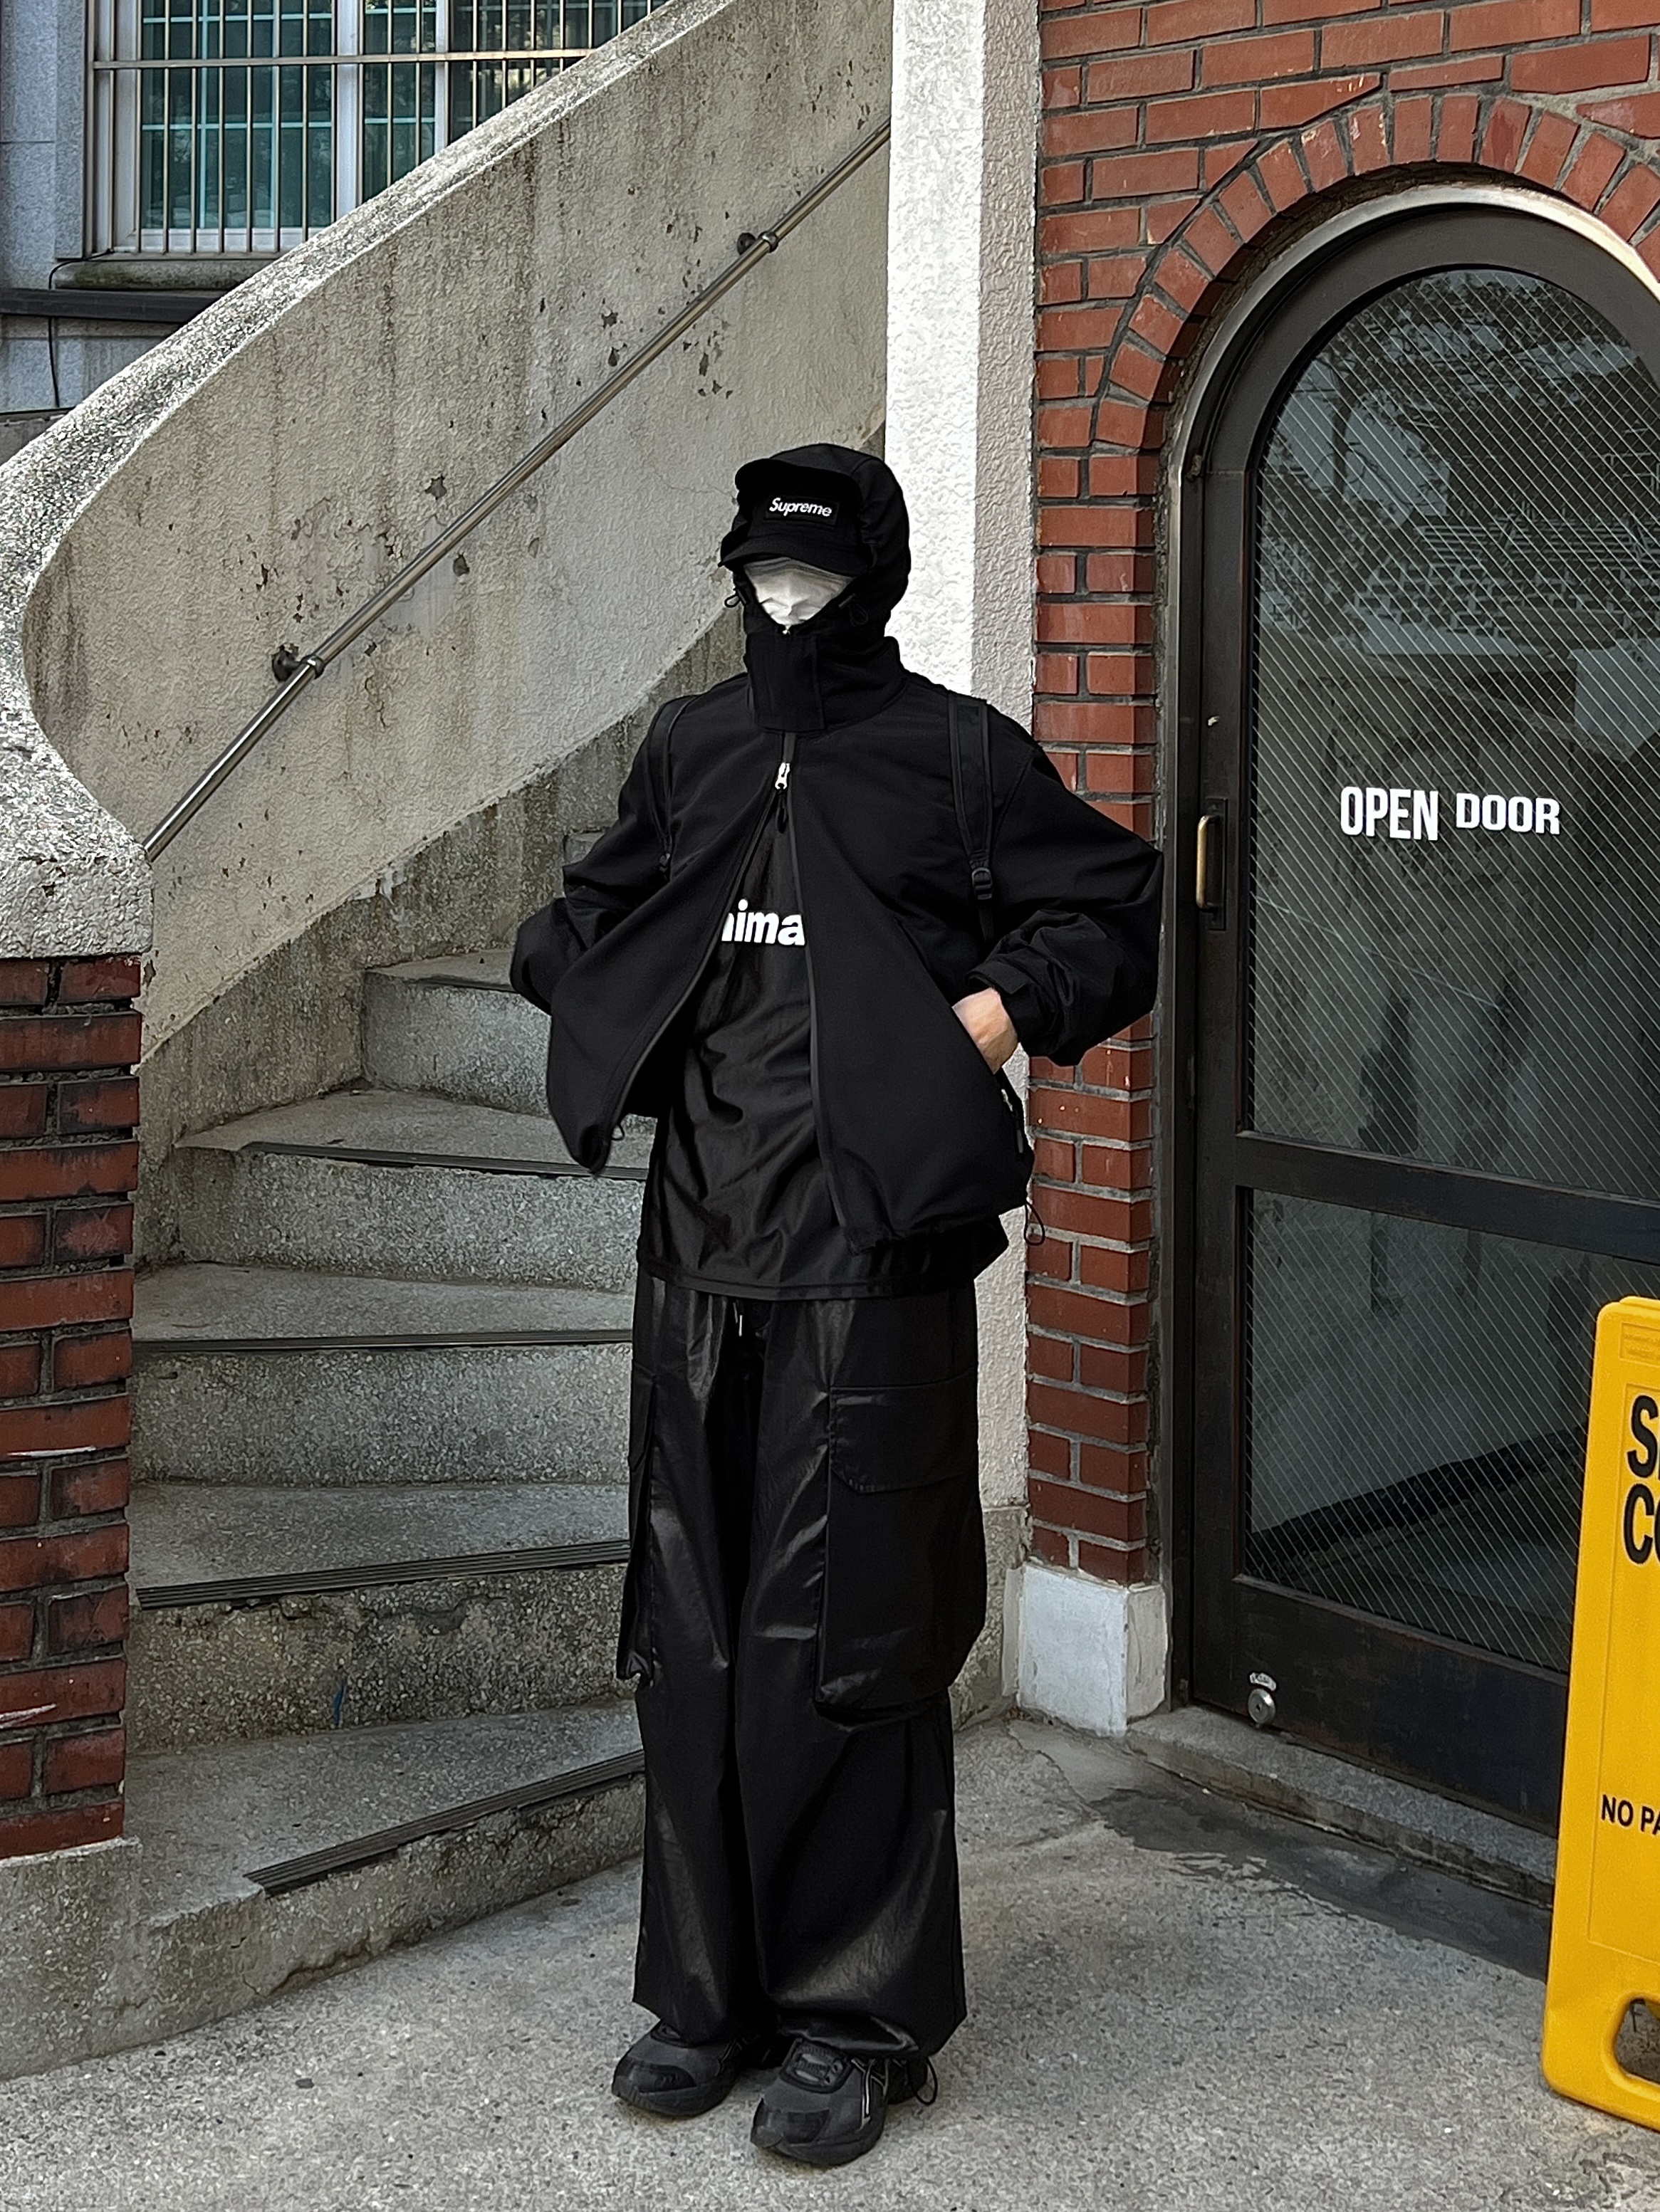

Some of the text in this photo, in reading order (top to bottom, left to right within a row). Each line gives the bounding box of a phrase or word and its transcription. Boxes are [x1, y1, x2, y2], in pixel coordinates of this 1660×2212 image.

[769, 497, 832, 517] Supreme
[1340, 786, 1560, 841] OPEN DOOR
[1602, 1794, 1634, 1827] NO
